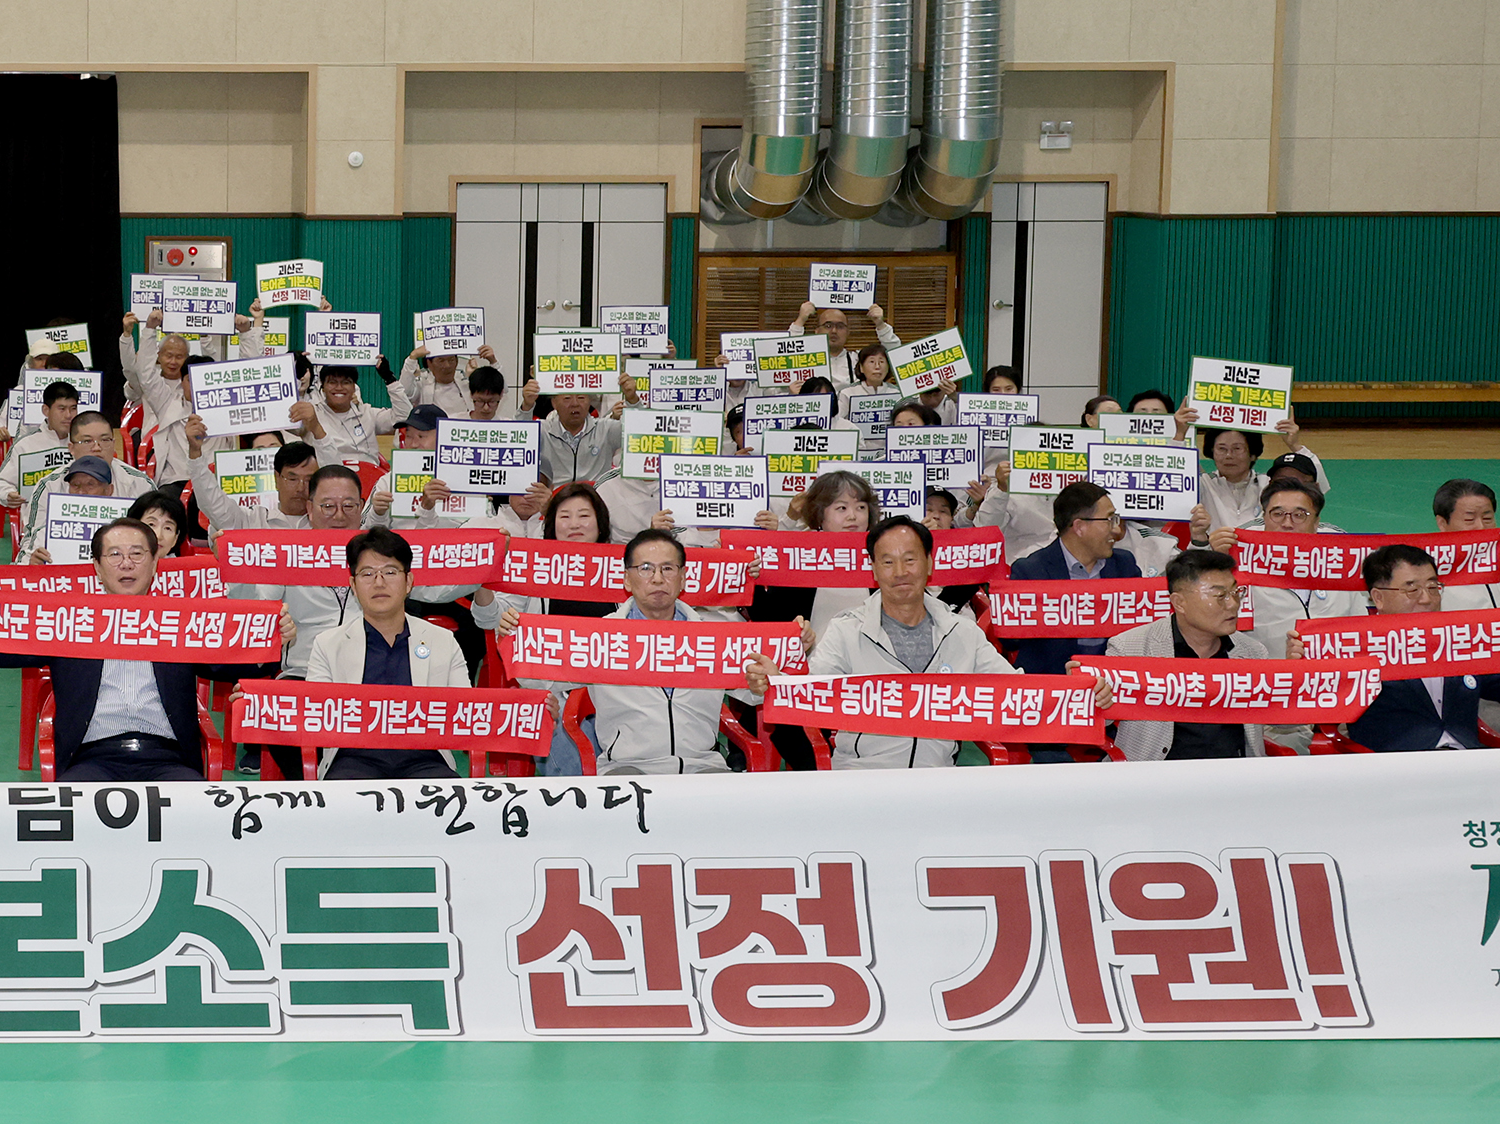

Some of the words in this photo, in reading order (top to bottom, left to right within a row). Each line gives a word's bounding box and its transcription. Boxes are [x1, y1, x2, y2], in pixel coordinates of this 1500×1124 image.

[279, 264, 303, 275] 괴산군
[260, 279, 286, 291] 농어촌
[288, 276, 320, 289] 기본소득
[812, 280, 834, 291] 농어촌
[836, 281, 849, 291] 기본
[851, 282, 873, 292] 소득이
[272, 291, 289, 302] 선정
[292, 290, 310, 300] 기원!
[830, 293, 853, 303] 만든다!
[562, 338, 593, 352] 괴산군
[778, 341, 804, 353] 괴산군
[539, 356, 571, 370] 농어촌
[574, 356, 616, 370] 기본소득
[760, 355, 786, 369] 농어촌
[789, 352, 826, 367] 기본소득
[204, 370, 239, 385] 인구소멸
[242, 367, 261, 379] 없는
[263, 365, 281, 378] 괴산
[554, 375, 575, 388] 선정
[578, 374, 602, 387] 기원!
[1223, 366, 1260, 385] 괴산군
[197, 390, 232, 410] 농어촌
[236, 387, 256, 402] 기본
[259, 382, 293, 400] 소득이
[1195, 383, 1233, 401] 농어촌
[1236, 387, 1286, 407] 기본소득
[229, 407, 266, 425] 만든다!
[1209, 405, 1235, 422] 선정
[1239, 408, 1267, 426] 기원!
[451, 429, 487, 443] 인구소멸
[489, 429, 507, 443] 없는
[510, 430, 527, 444] 괴산
[440, 446, 475, 464] 농어촌
[478, 448, 499, 464] 기본
[502, 449, 535, 466] 소득이
[1103, 452, 1142, 467] 인구소멸
[1144, 454, 1164, 468] 없는
[1167, 455, 1185, 469] 괴산
[469, 470, 506, 485] 만든다!
[674, 464, 712, 477] 인구소멸
[714, 464, 732, 477] 없는
[735, 464, 754, 477] 괴산
[665, 481, 701, 497] 농어촌
[705, 482, 726, 497] 기본
[728, 482, 764, 498] 소득이
[1093, 471, 1128, 488] 농어촌
[1133, 473, 1156, 489] 기본
[1158, 474, 1194, 491] 소득이
[697, 503, 734, 518] 만든다!
[1125, 494, 1164, 510] 만든다!
[782, 545, 856, 571] 기본소득!
[935, 542, 1001, 571] 선정한다
[1238, 541, 1288, 574] 괴산군
[1294, 544, 1343, 579] 농어촌
[1462, 541, 1496, 573] 기원!
[1042, 591, 1095, 624] 농어촌
[1100, 591, 1171, 624] 기본소득
[35, 606, 94, 643] 농어촌
[100, 607, 179, 647] 기본소득
[184, 609, 224, 648] 선정
[230, 609, 275, 648] 기원!
[1145, 671, 1205, 706] 농어촌
[1209, 673, 1293, 709] 기본소득
[1298, 671, 1341, 708] 선정
[773, 675, 835, 714] 괴산군
[840, 677, 903, 718] 농어촌
[908, 683, 994, 721] 기본소득
[1000, 687, 1045, 725] 선정
[1051, 689, 1095, 727] 기원!
[242, 696, 297, 731] 괴산군
[303, 697, 362, 734] 농어촌
[367, 698, 447, 736] 기본소득
[452, 698, 492, 738] 선정
[497, 702, 543, 741] 기원!
[8, 786, 172, 842] 담아
[209, 785, 326, 840] 함께
[355, 779, 653, 836] 기원합니다
[516, 863, 873, 1033] 선정
[920, 855, 1365, 1027] 기원!
